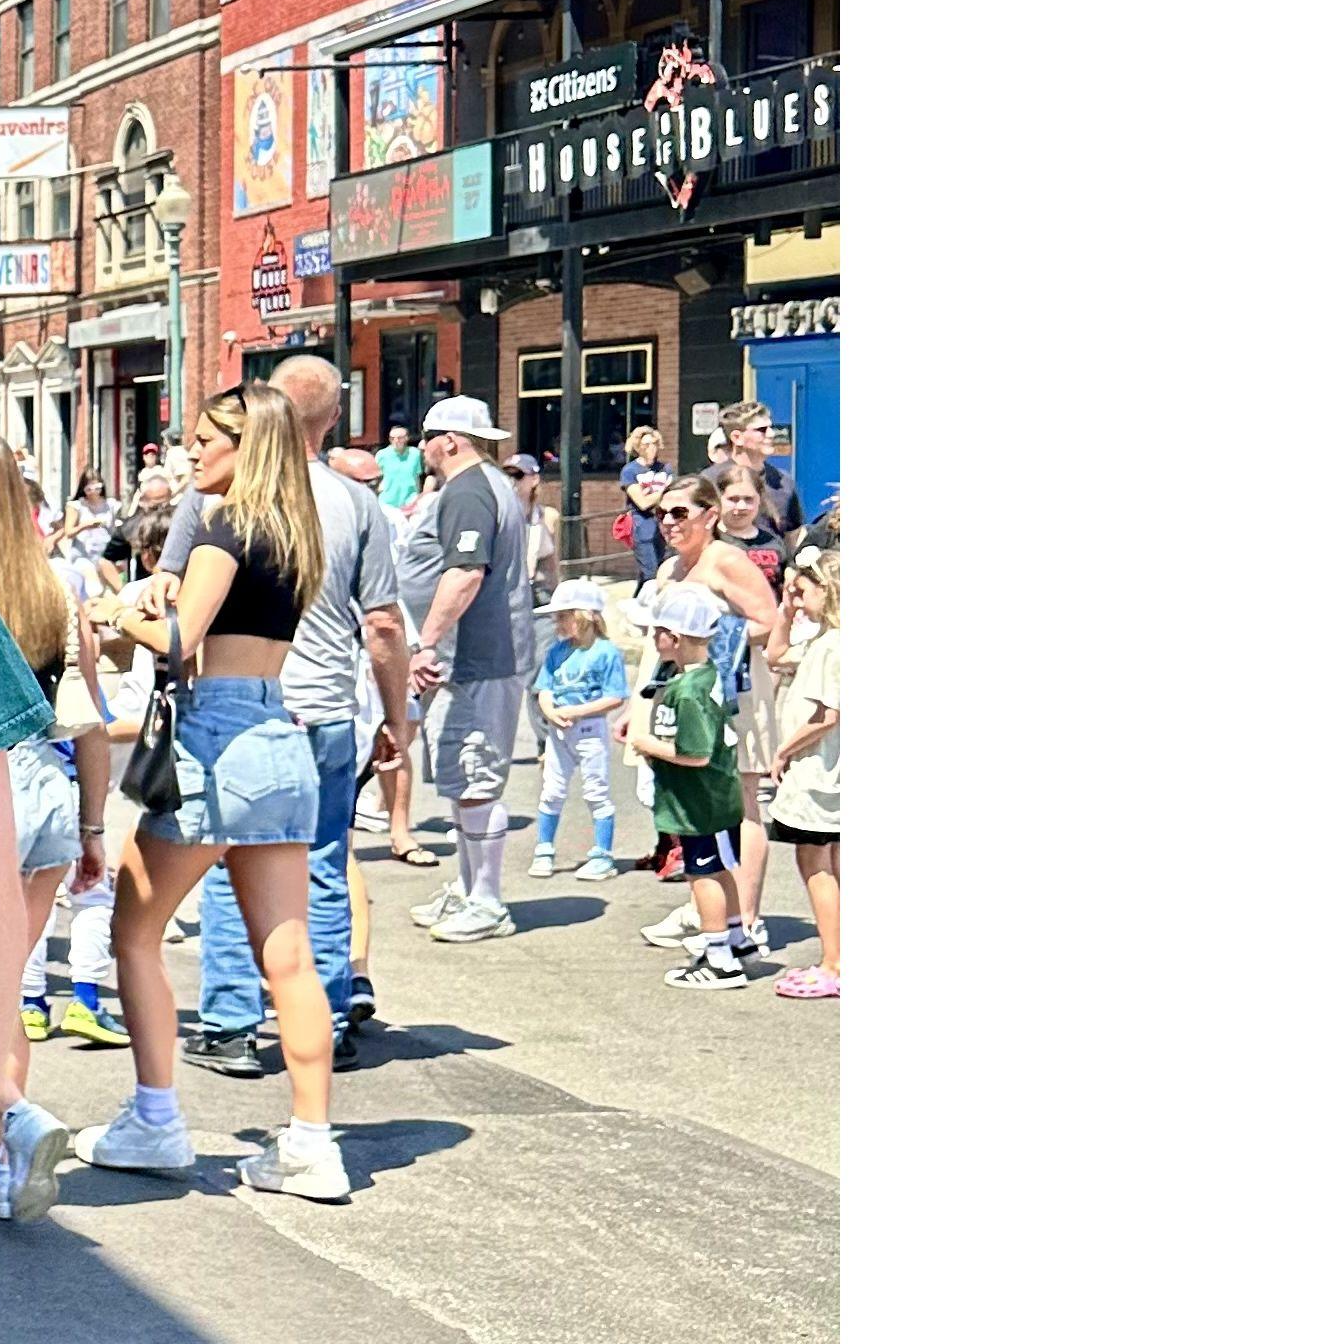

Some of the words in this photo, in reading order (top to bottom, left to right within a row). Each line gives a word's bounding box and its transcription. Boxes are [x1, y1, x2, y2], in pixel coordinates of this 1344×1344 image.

[547, 64, 617, 107] Citizens
[527, 126, 647, 194] HOUSE
[690, 83, 830, 160] BLUES
